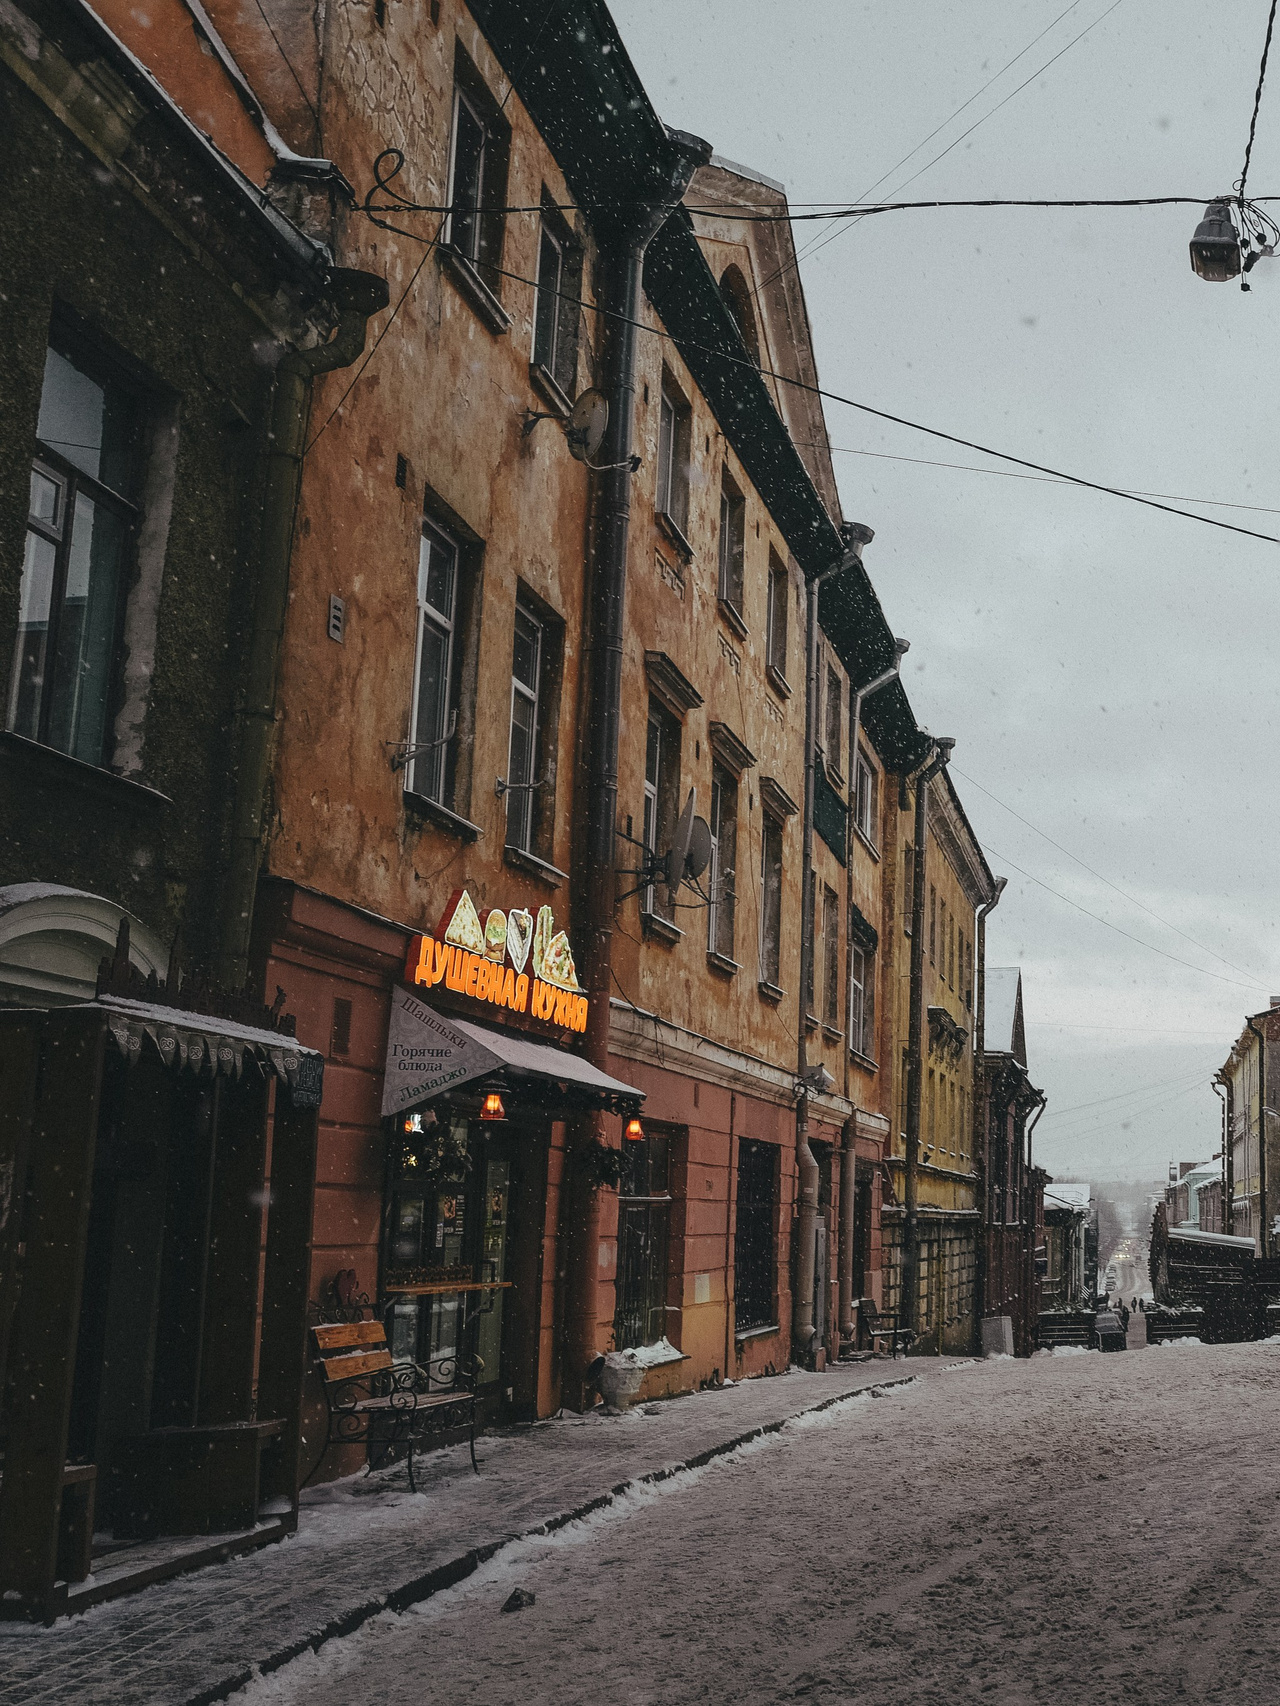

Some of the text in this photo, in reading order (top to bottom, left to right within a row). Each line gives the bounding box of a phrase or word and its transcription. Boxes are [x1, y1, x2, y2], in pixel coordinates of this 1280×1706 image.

[415, 935, 589, 1033] ДУШЕВНАЯ КУХНЯ
[400, 996, 468, 1050] Шашлыки
[391, 1043, 452, 1059] Горячие
[398, 1059, 443, 1072] блюда
[400, 1065, 468, 1102] Ламаджо
